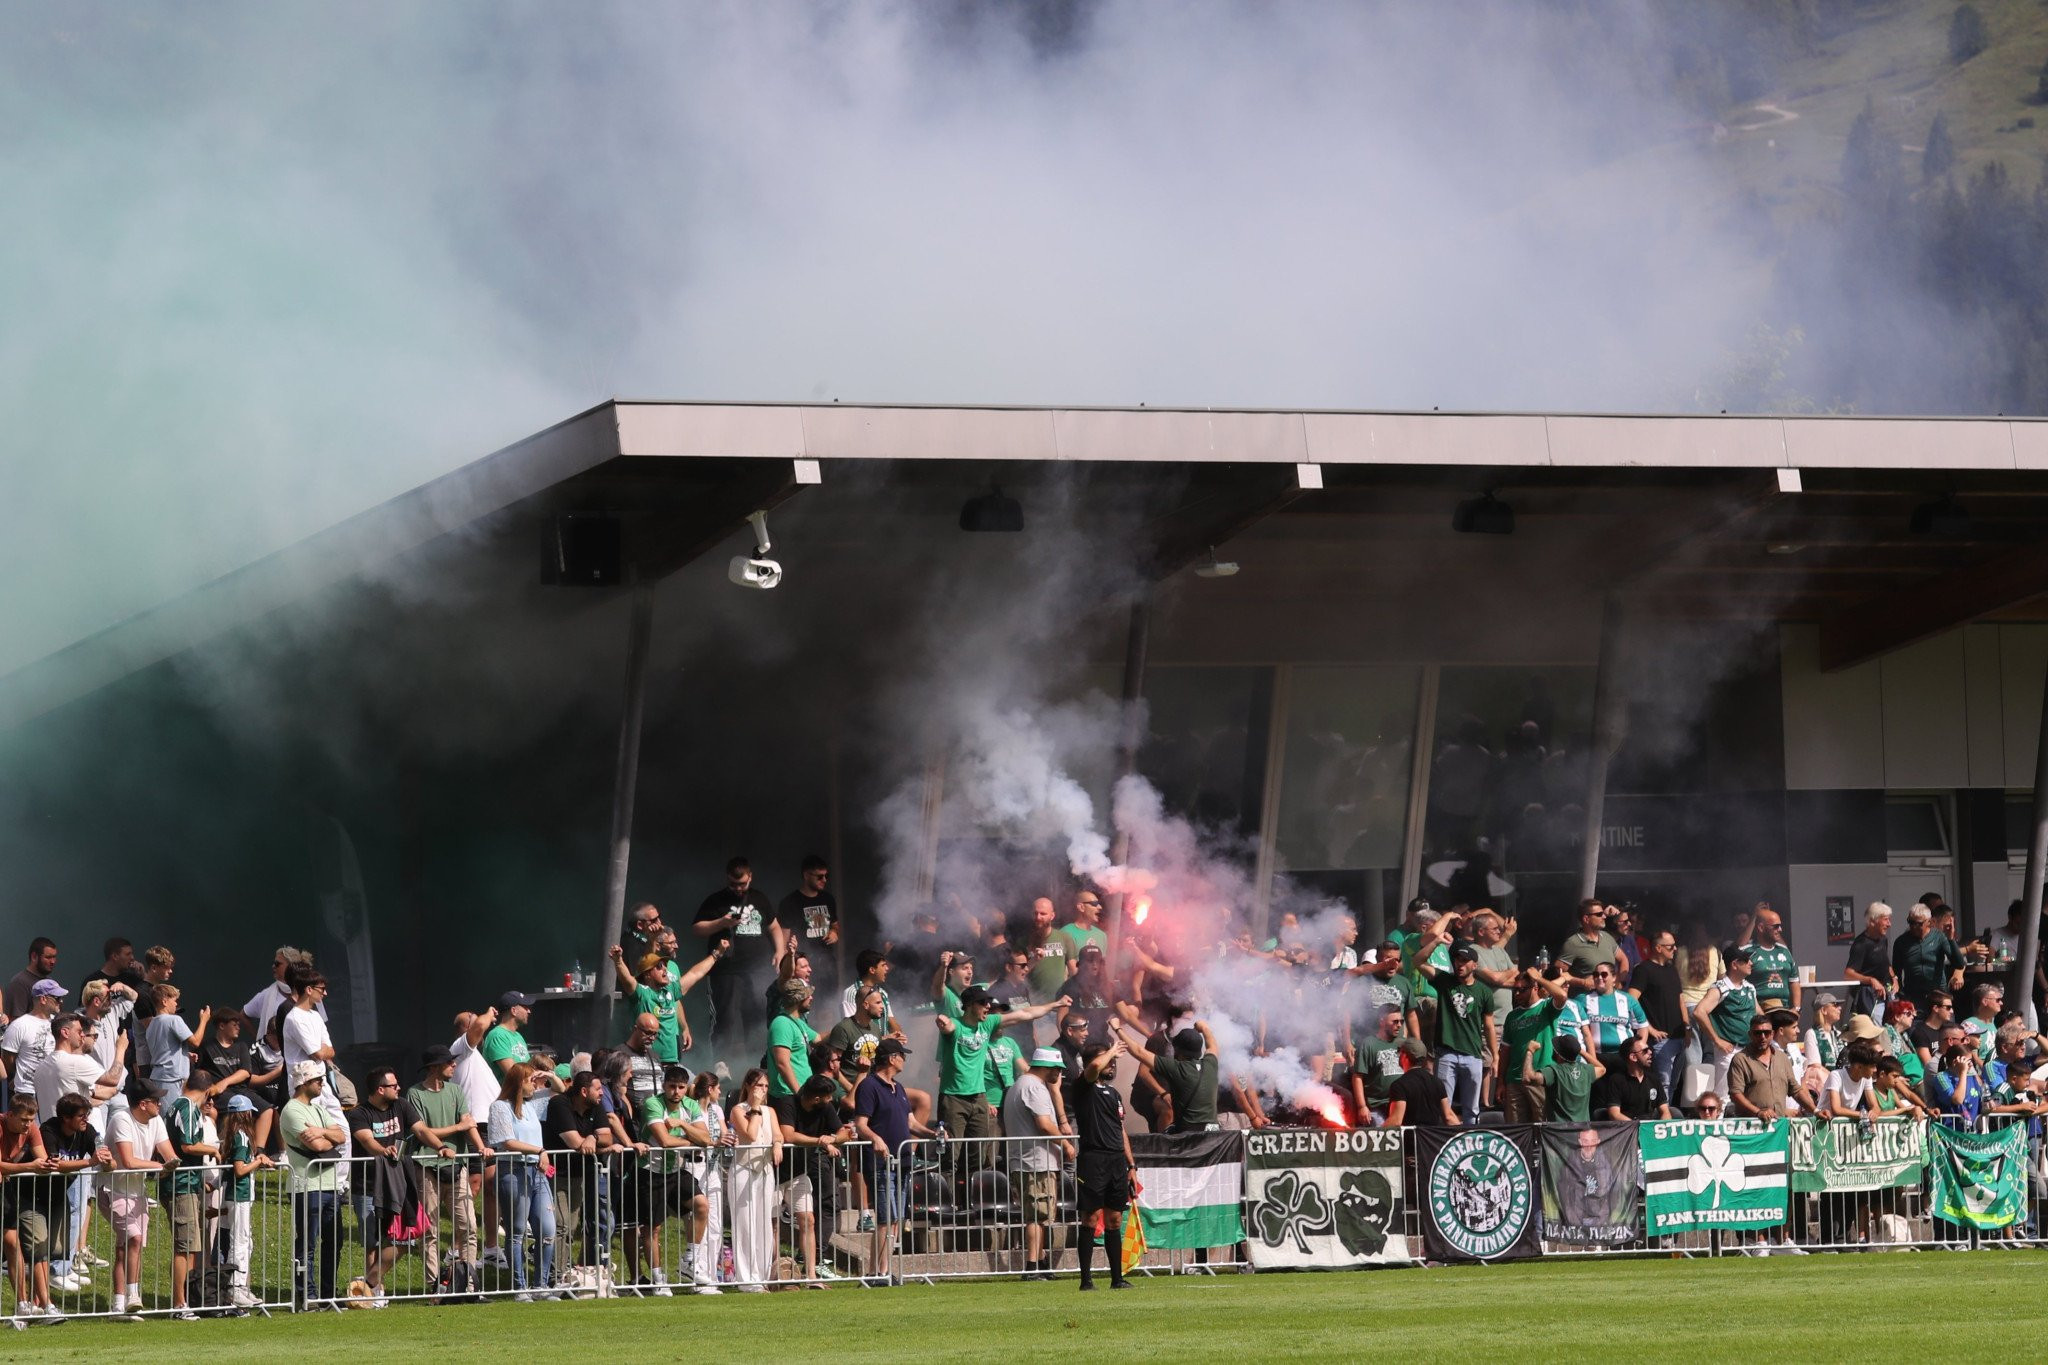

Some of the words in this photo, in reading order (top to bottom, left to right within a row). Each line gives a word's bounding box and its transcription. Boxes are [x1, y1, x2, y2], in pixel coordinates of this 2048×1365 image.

[1570, 826, 1644, 847] KNTINE
[1247, 1131, 1328, 1156] GREEN
[1334, 1129, 1400, 1153] BOYS
[1433, 1134, 1484, 1198] NÜRNBERG
[1488, 1138, 1519, 1172] GATE
[1512, 1174, 1527, 1193] 13
[1439, 1205, 1525, 1254] PANATHINAIKOS
